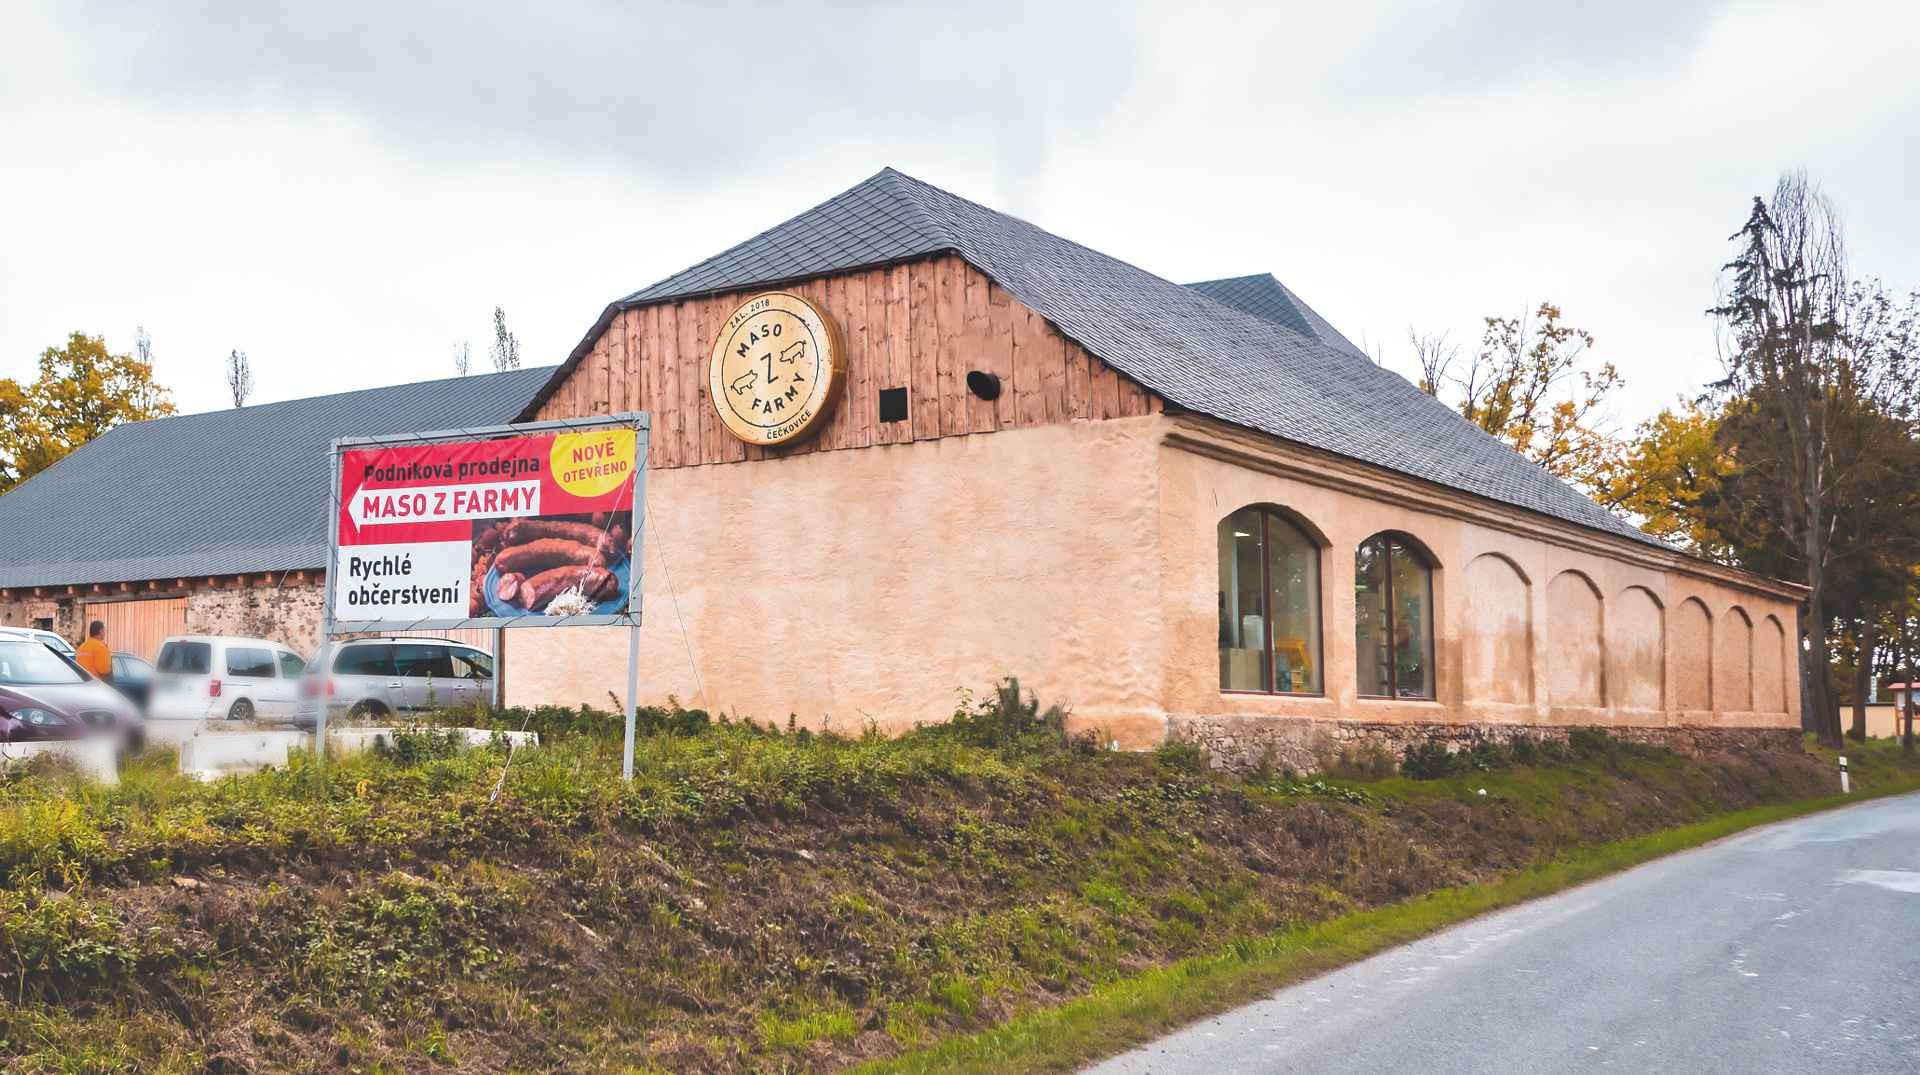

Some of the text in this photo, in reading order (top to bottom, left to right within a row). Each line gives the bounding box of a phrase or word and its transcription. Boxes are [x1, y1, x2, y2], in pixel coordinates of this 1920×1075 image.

[750, 299, 770, 312] 2018
[736, 323, 782, 358] MASO
[760, 352, 779, 384] Z
[751, 372, 805, 414] FARMY
[766, 409, 812, 440] ČEČKOVICE
[572, 437, 616, 464] NOVĚ
[364, 455, 541, 482] Podniková prodejna
[362, 486, 537, 519] MASO Z FARMY
[350, 552, 412, 580] Rychlé
[348, 580, 460, 606] občerstvení
